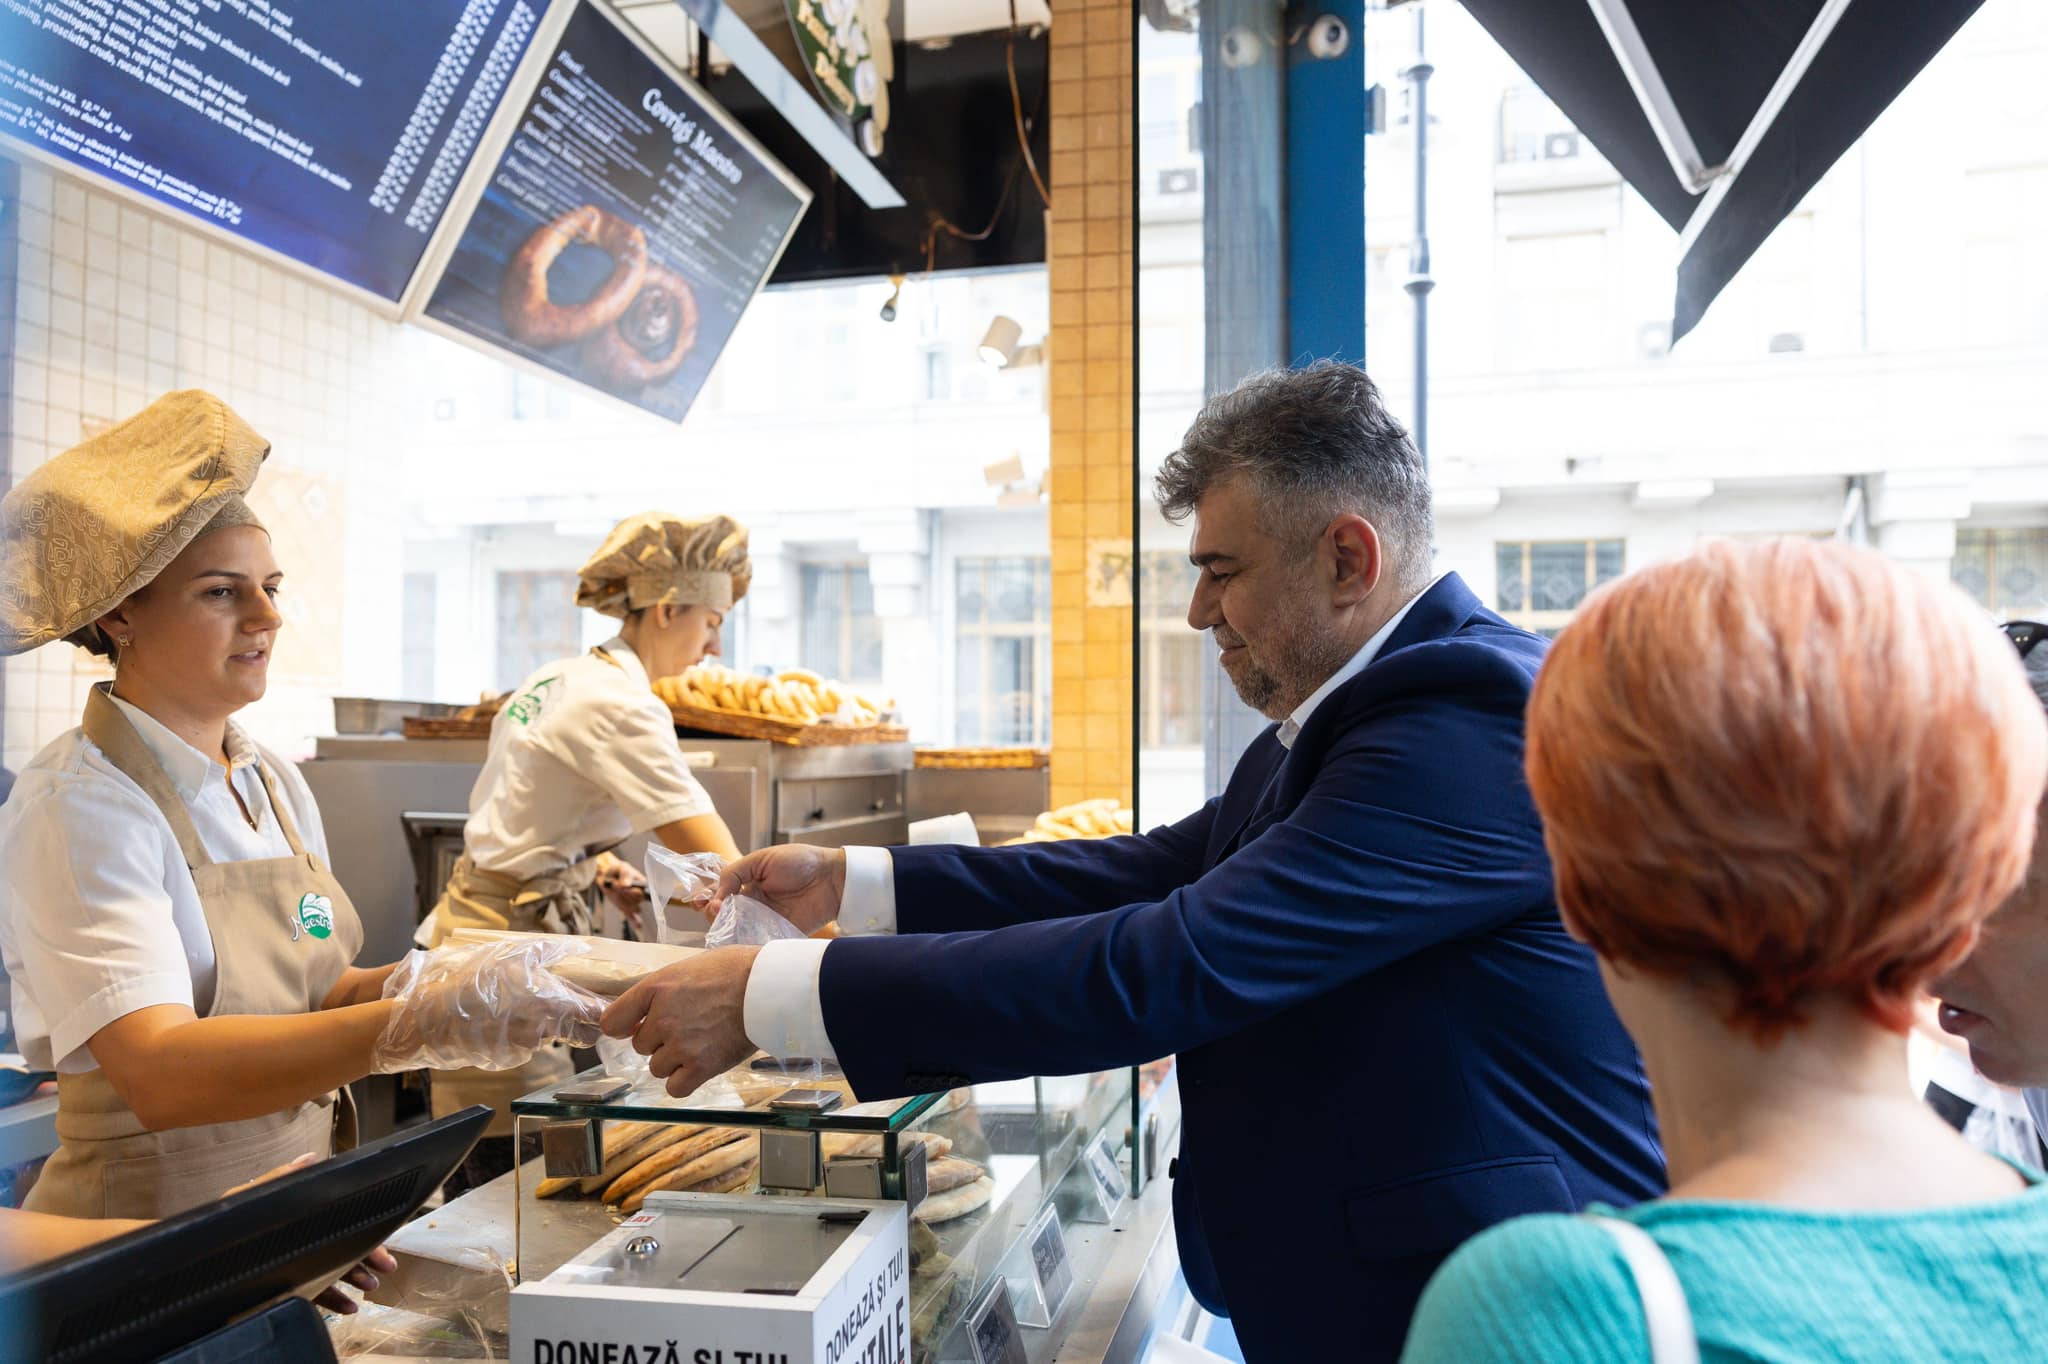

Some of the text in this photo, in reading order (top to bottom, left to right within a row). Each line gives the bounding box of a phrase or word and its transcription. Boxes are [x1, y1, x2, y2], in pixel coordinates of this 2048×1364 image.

[643, 89, 696, 144] Covrigi
[690, 129, 743, 185] Maestro
[290, 913, 334, 942] Maestro
[826, 1280, 875, 1364] DONEAZĂ
[888, 1247, 903, 1288] TU!
[534, 1338, 680, 1364] DONEAZĂ
